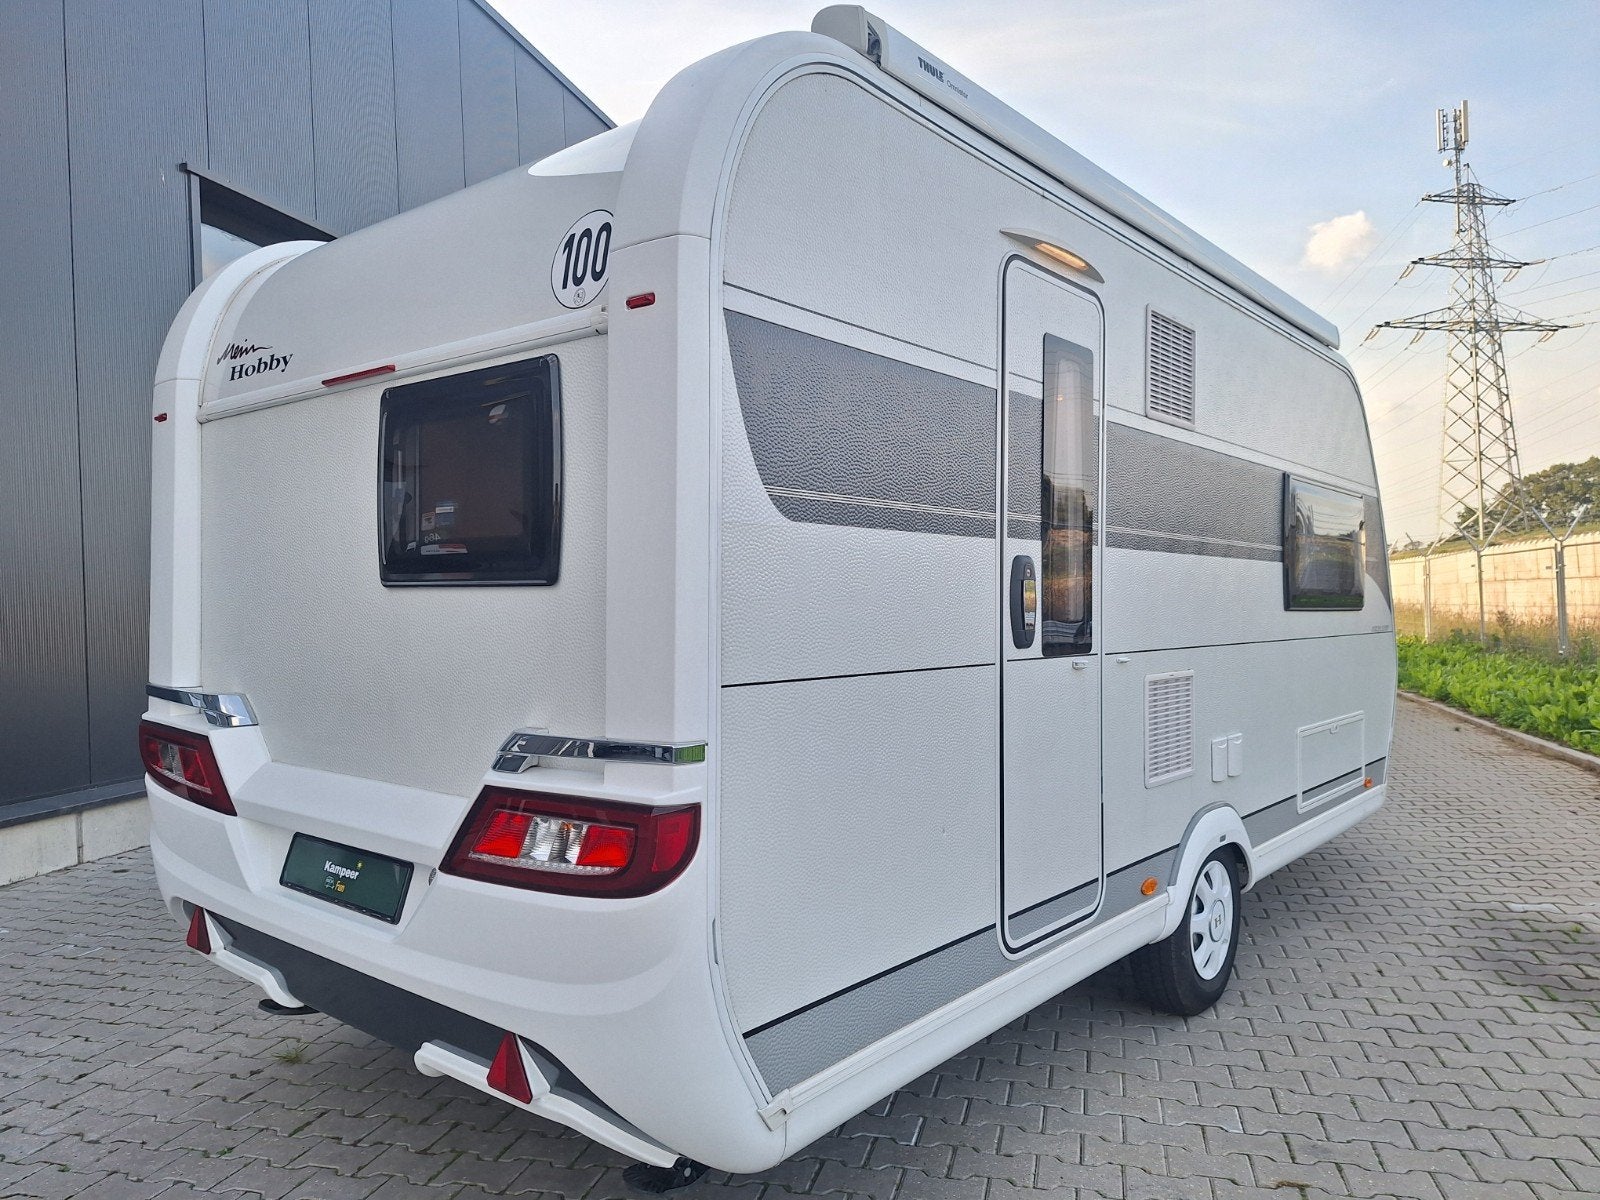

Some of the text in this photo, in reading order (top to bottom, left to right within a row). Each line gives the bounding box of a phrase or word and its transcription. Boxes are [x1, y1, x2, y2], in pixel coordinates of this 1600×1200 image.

[917, 56, 944, 83] THULE
[562, 222, 612, 290] 100
[229, 353, 294, 381] Hobby
[323, 860, 360, 880] Kampeer
